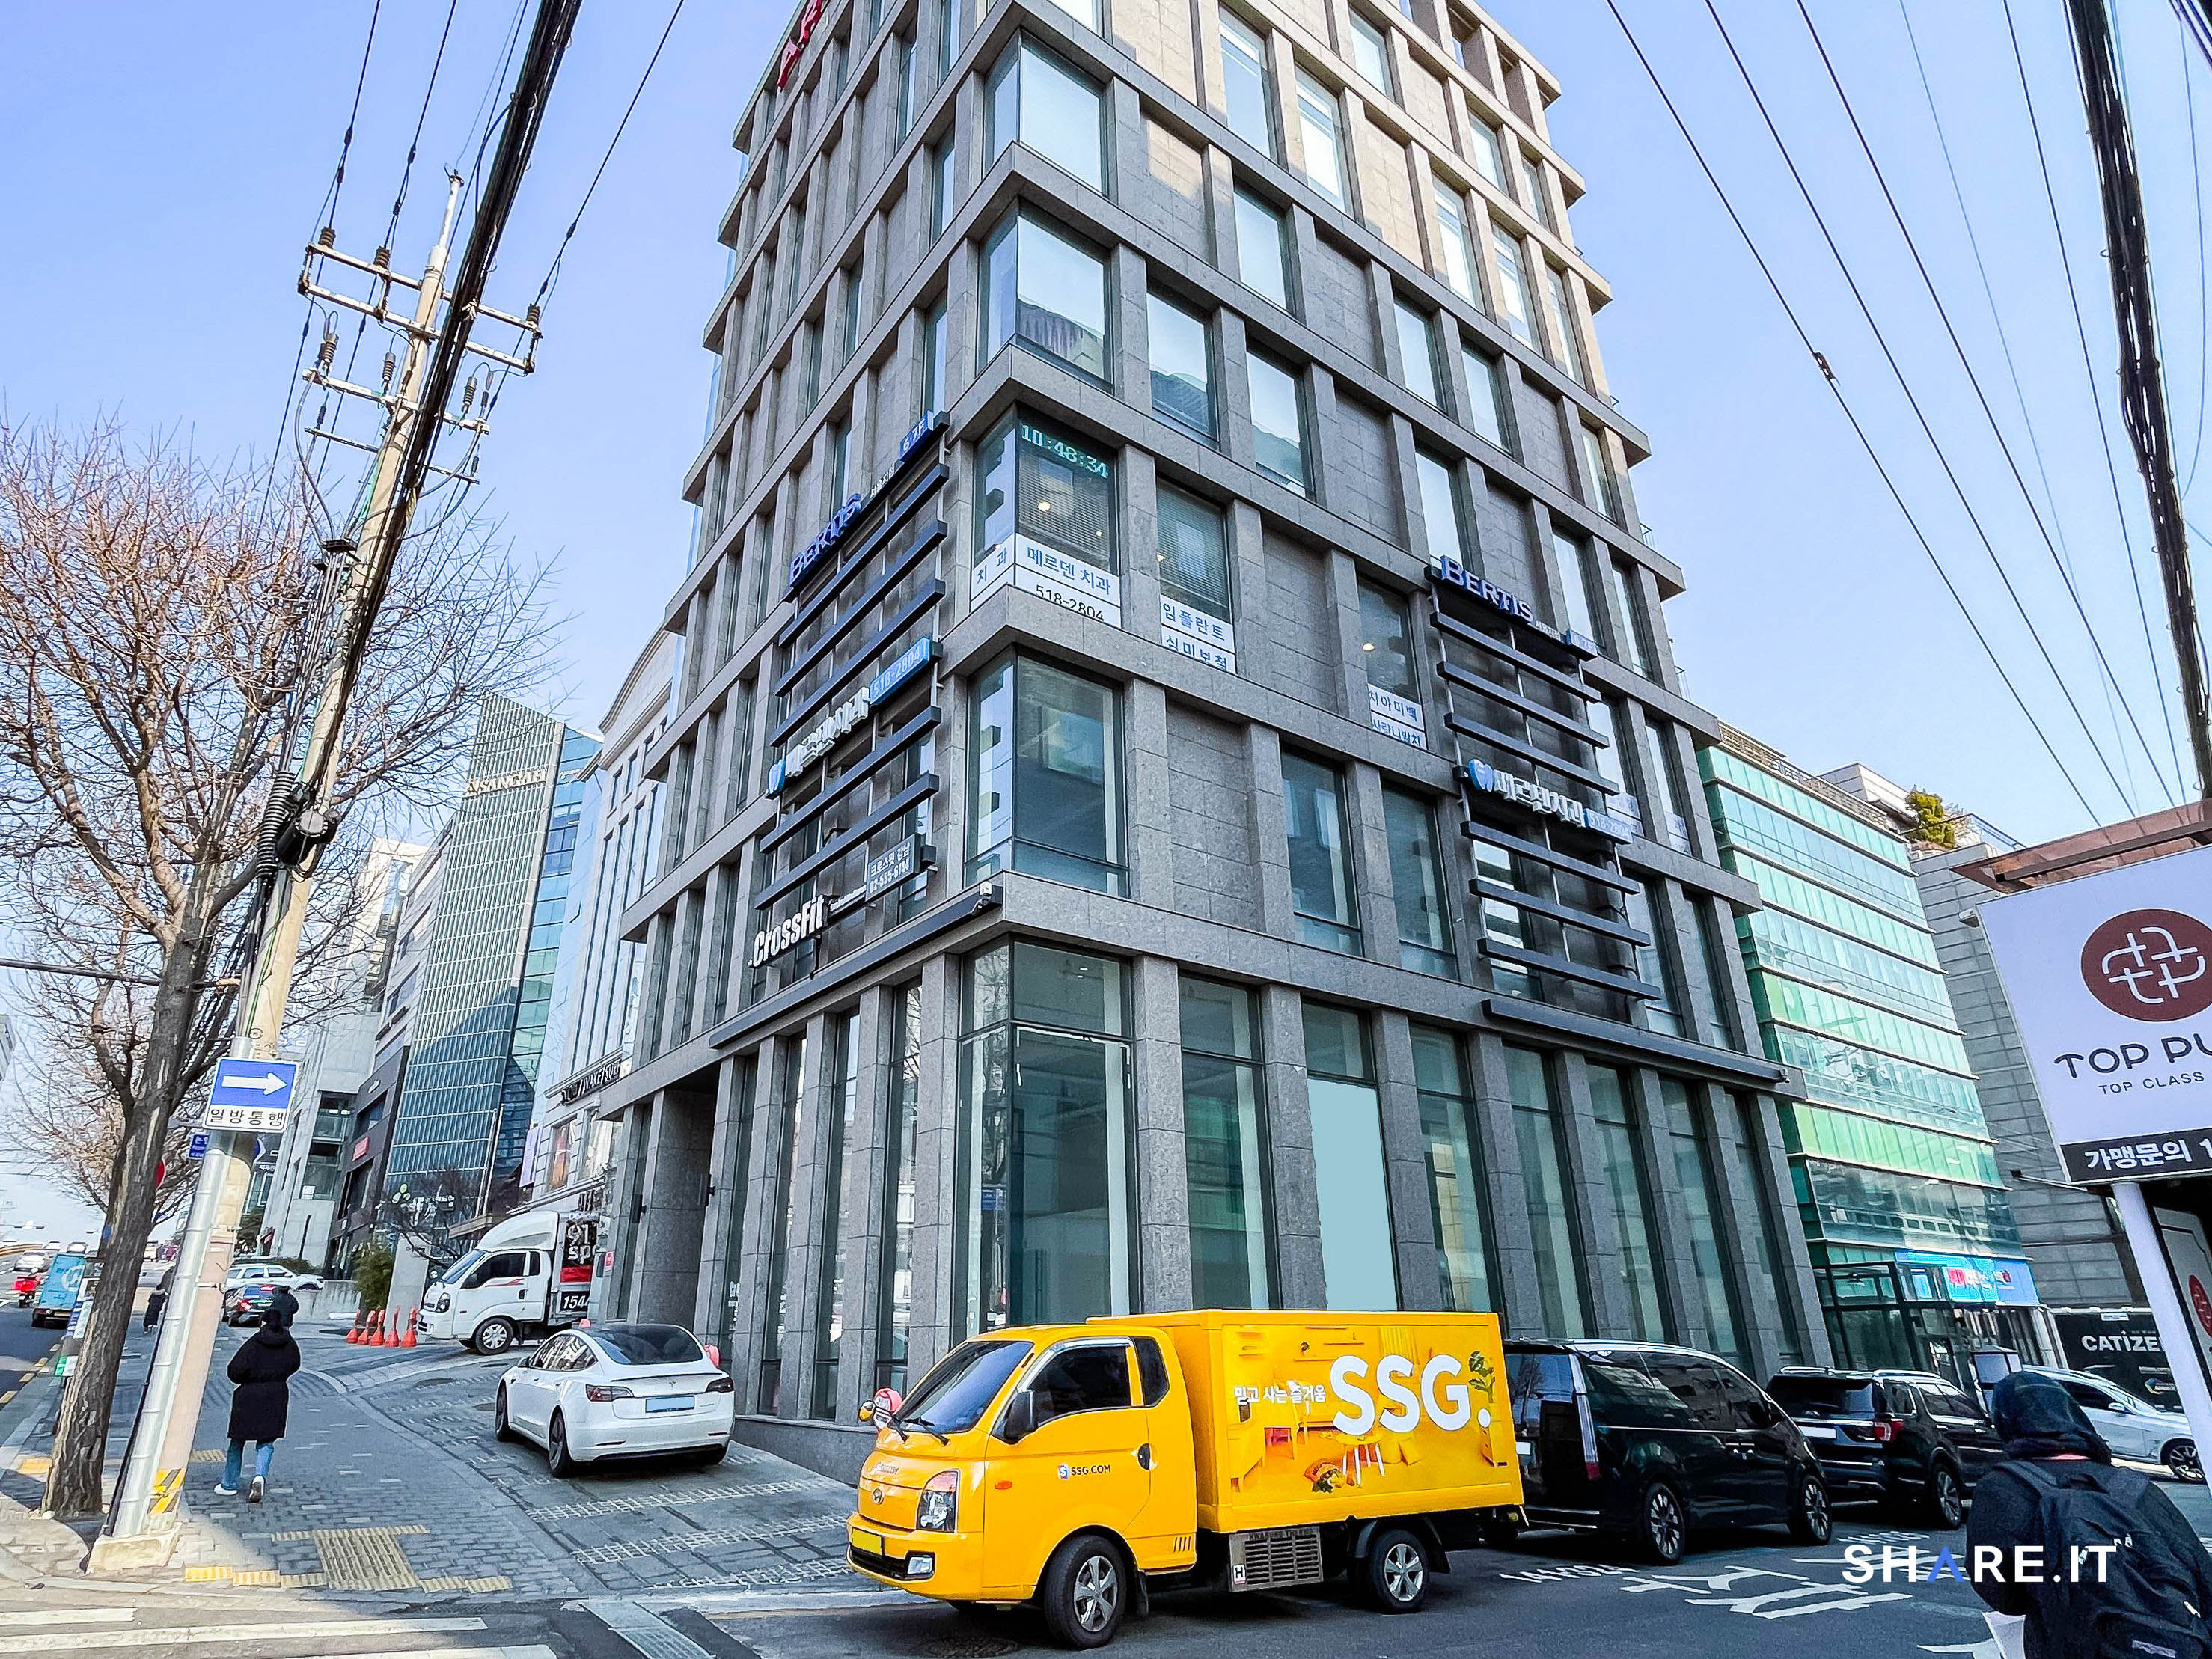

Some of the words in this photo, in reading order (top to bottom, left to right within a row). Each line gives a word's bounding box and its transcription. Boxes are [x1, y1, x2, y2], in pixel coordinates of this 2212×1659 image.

[1021, 424, 1109, 479] 10:48:34
[790, 494, 861, 587] BERTIS
[1027, 547, 1075, 581] 메르덴
[1080, 569, 1111, 595] 치과
[1440, 554, 1535, 623] BERTIS
[1163, 603, 1225, 641] 임플란트
[1166, 635, 1227, 670] 심미보철
[873, 644, 920, 697] 518-2804
[1369, 690, 1417, 722] 치아미백
[870, 852, 895, 877] 크로스핏
[897, 842, 911, 861] 강남
[752, 894, 825, 967] CrossFit
[2054, 1043, 2149, 1078] TOP
[2098, 1081, 2133, 1094] TOP
[2142, 1072, 2205, 1089] CLASS
[210, 1109, 283, 1127] 일방통행
[2084, 1139, 2193, 1170] 가맹문의
[1233, 1385, 1260, 1404] 믿고
[1263, 1385, 1287, 1404] 사는
[1289, 1384, 1326, 1404] 즐거움
[1071, 1464, 1110, 1476] SSG.COM
